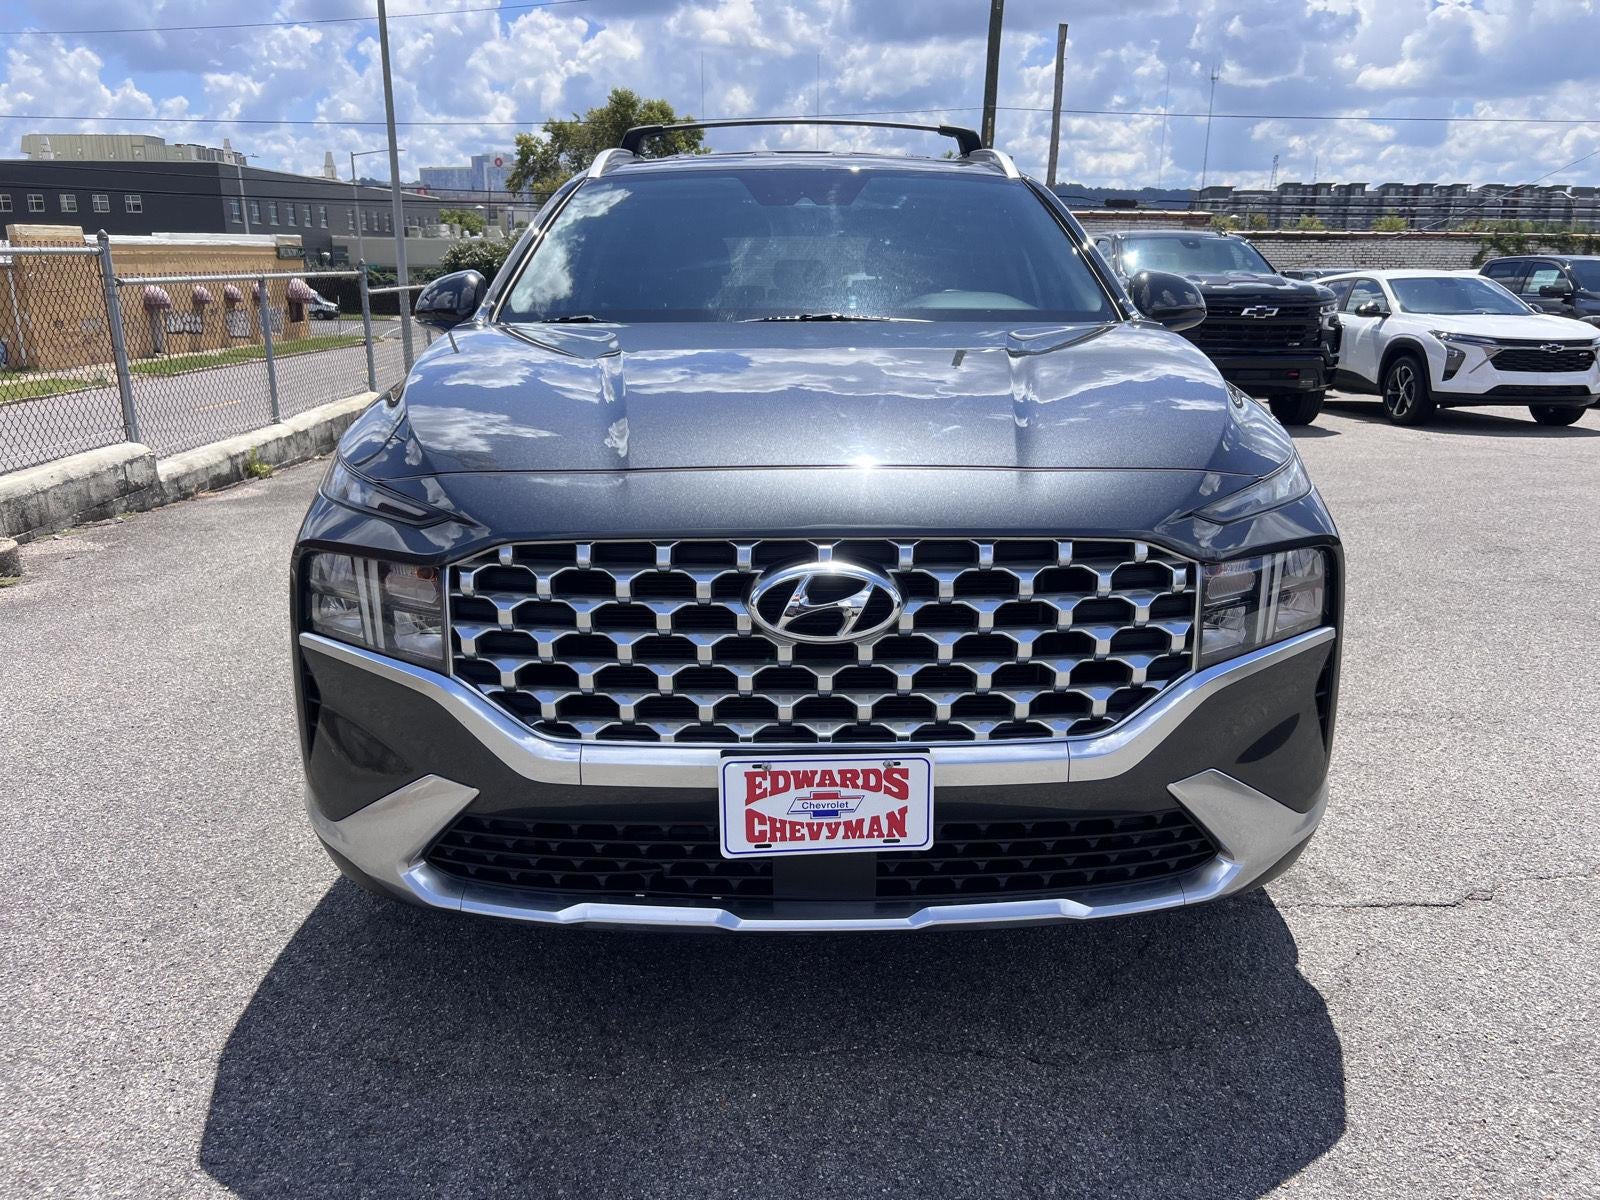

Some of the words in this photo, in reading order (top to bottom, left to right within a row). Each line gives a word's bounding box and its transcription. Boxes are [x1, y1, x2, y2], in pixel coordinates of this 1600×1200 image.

[744, 767, 910, 806] EDWARDS
[801, 800, 849, 810] Chevrolet
[745, 805, 908, 843] CHEVYMAN
